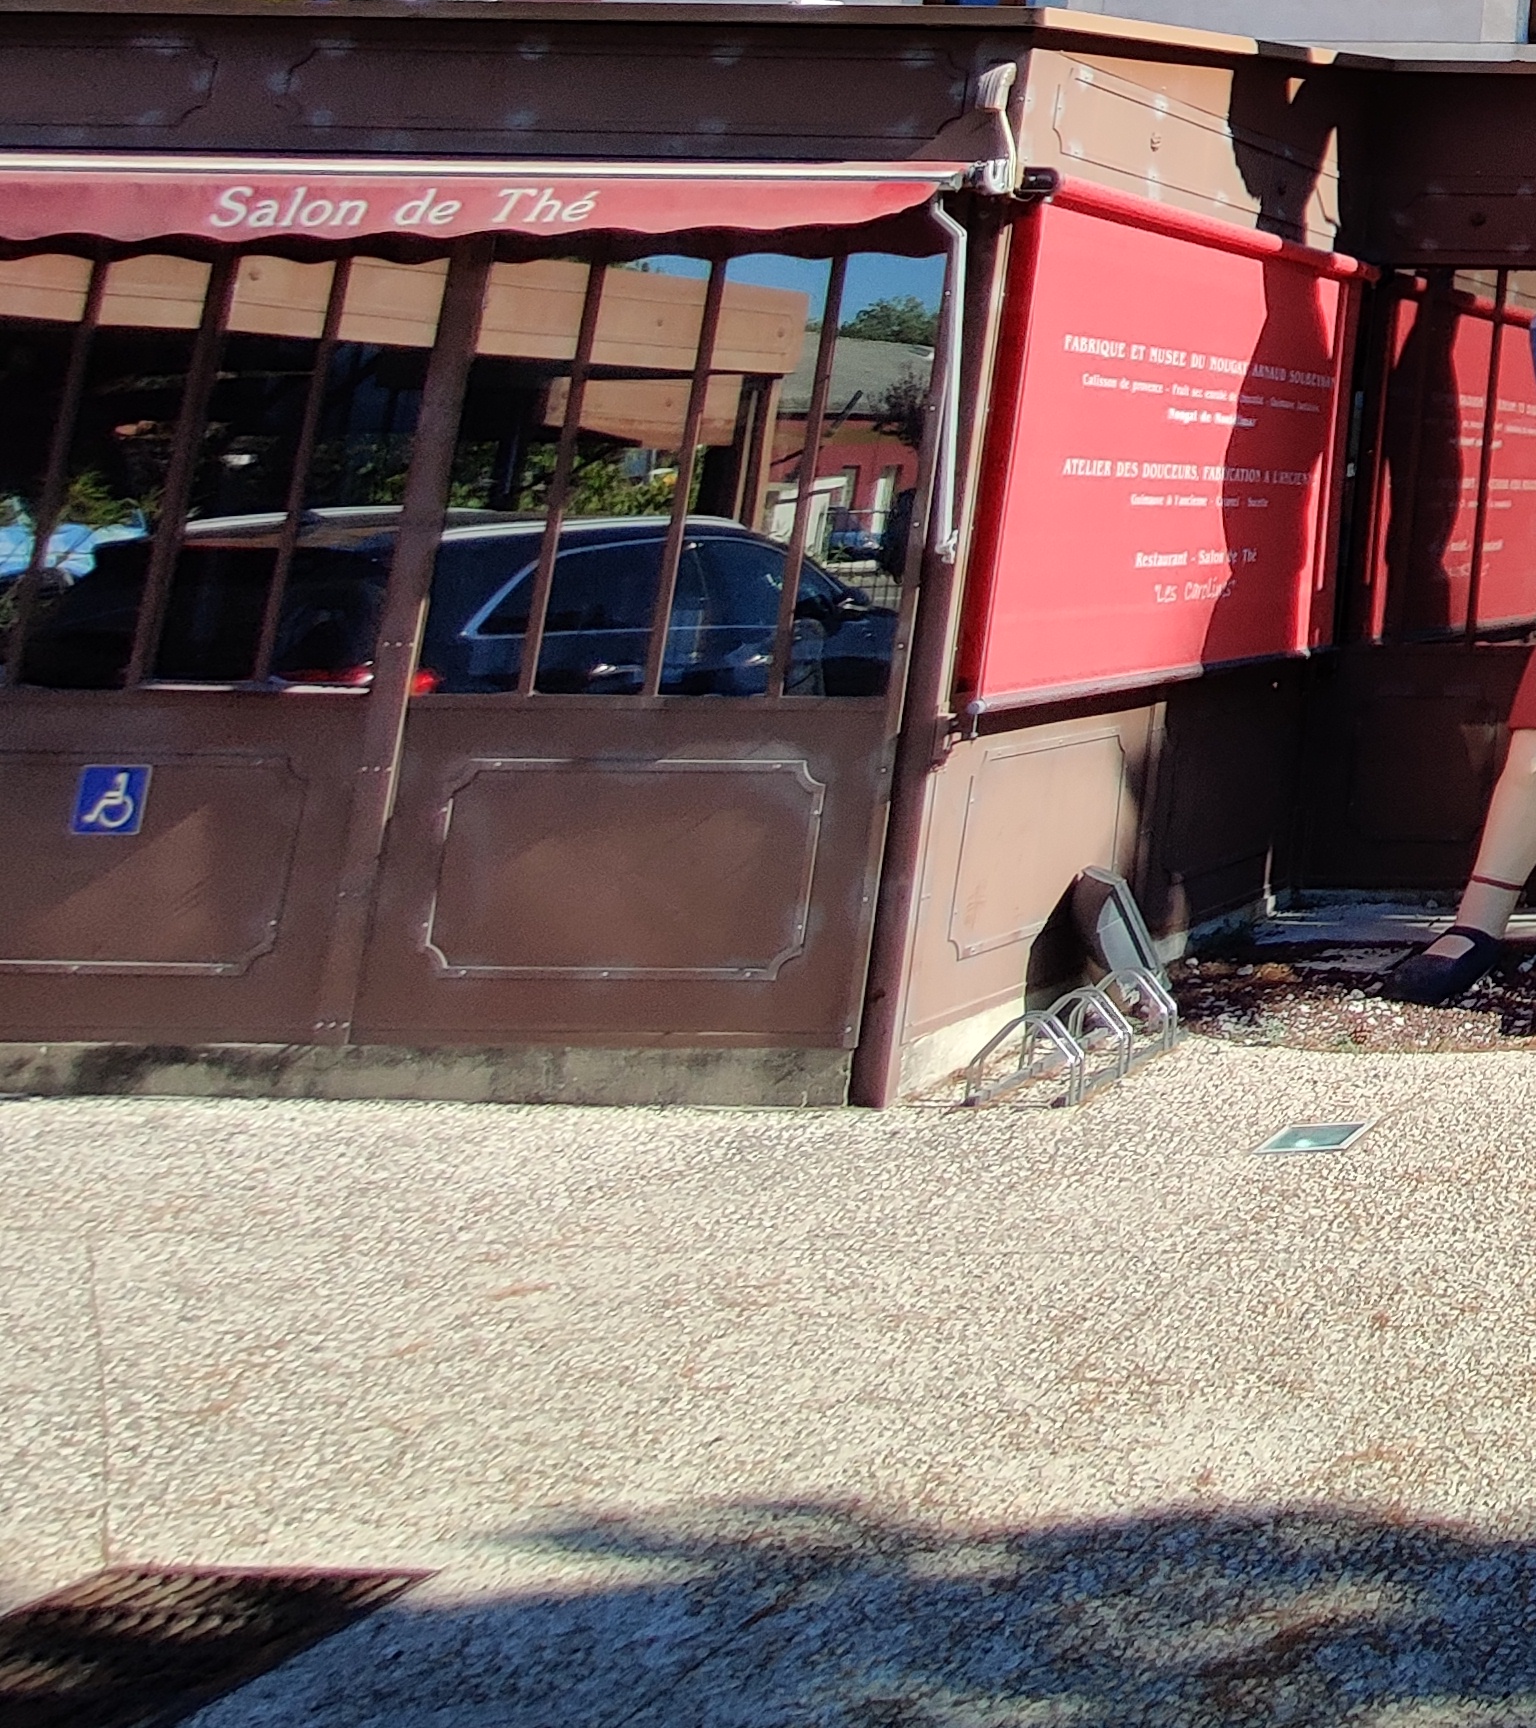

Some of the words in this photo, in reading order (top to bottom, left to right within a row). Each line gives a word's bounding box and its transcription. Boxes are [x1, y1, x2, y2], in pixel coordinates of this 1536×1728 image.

[210, 186, 367, 230] Salon
[393, 187, 462, 229] de
[494, 187, 598, 225] Thé
[1064, 334, 1127, 359] FABRIQUE
[1130, 344, 1147, 362] ET
[1149, 347, 1187, 368] MUSEE
[1190, 353, 1206, 369] DU
[1062, 457, 1113, 478] ATELIER
[1116, 460, 1140, 479] DES
[1134, 549, 1188, 568] Restaurant
